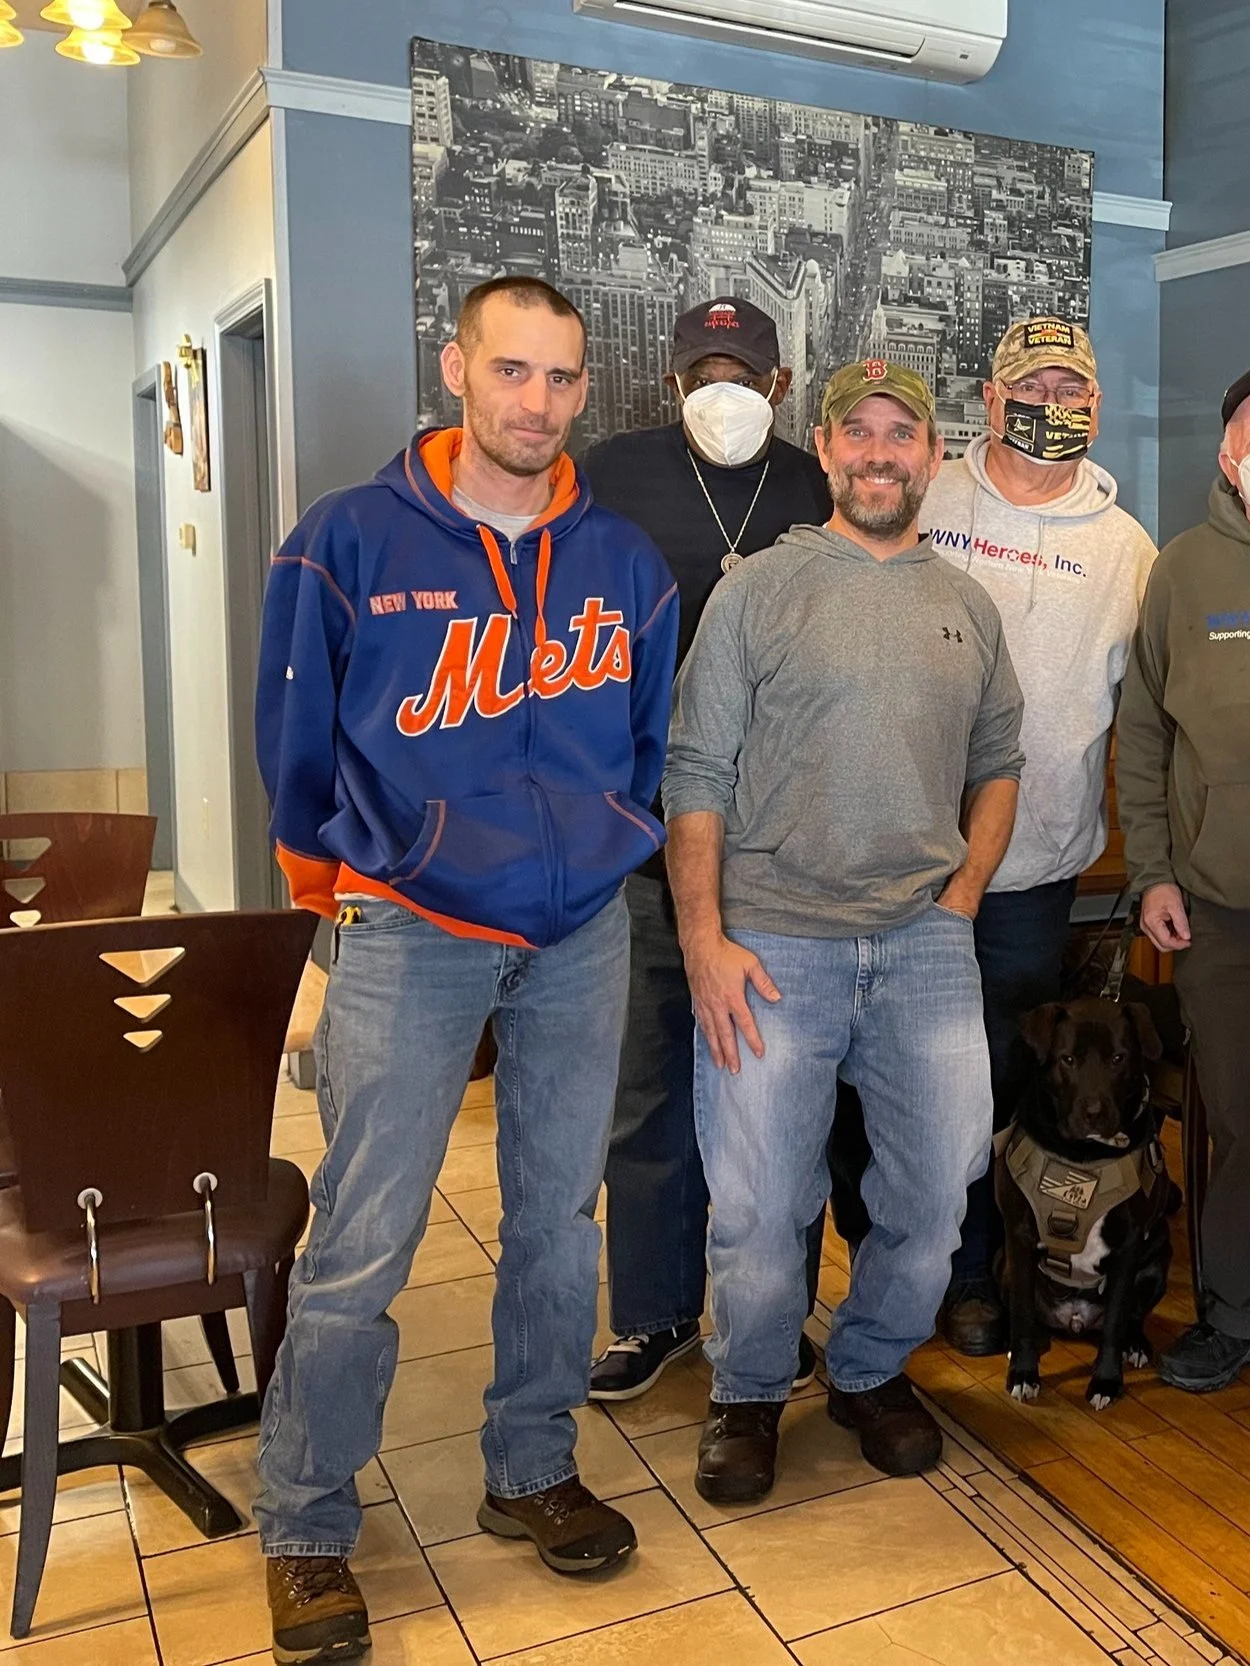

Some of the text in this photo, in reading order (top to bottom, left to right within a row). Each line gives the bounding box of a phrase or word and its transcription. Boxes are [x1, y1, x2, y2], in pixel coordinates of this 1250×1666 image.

[1028, 323, 1070, 333] VIETNAM
[1028, 336, 1071, 345] VETERAN
[862, 359, 887, 381] B
[1055, 555, 1087, 577] Inc.
[369, 591, 458, 615] NEW YORK
[396, 597, 631, 736] Mets
